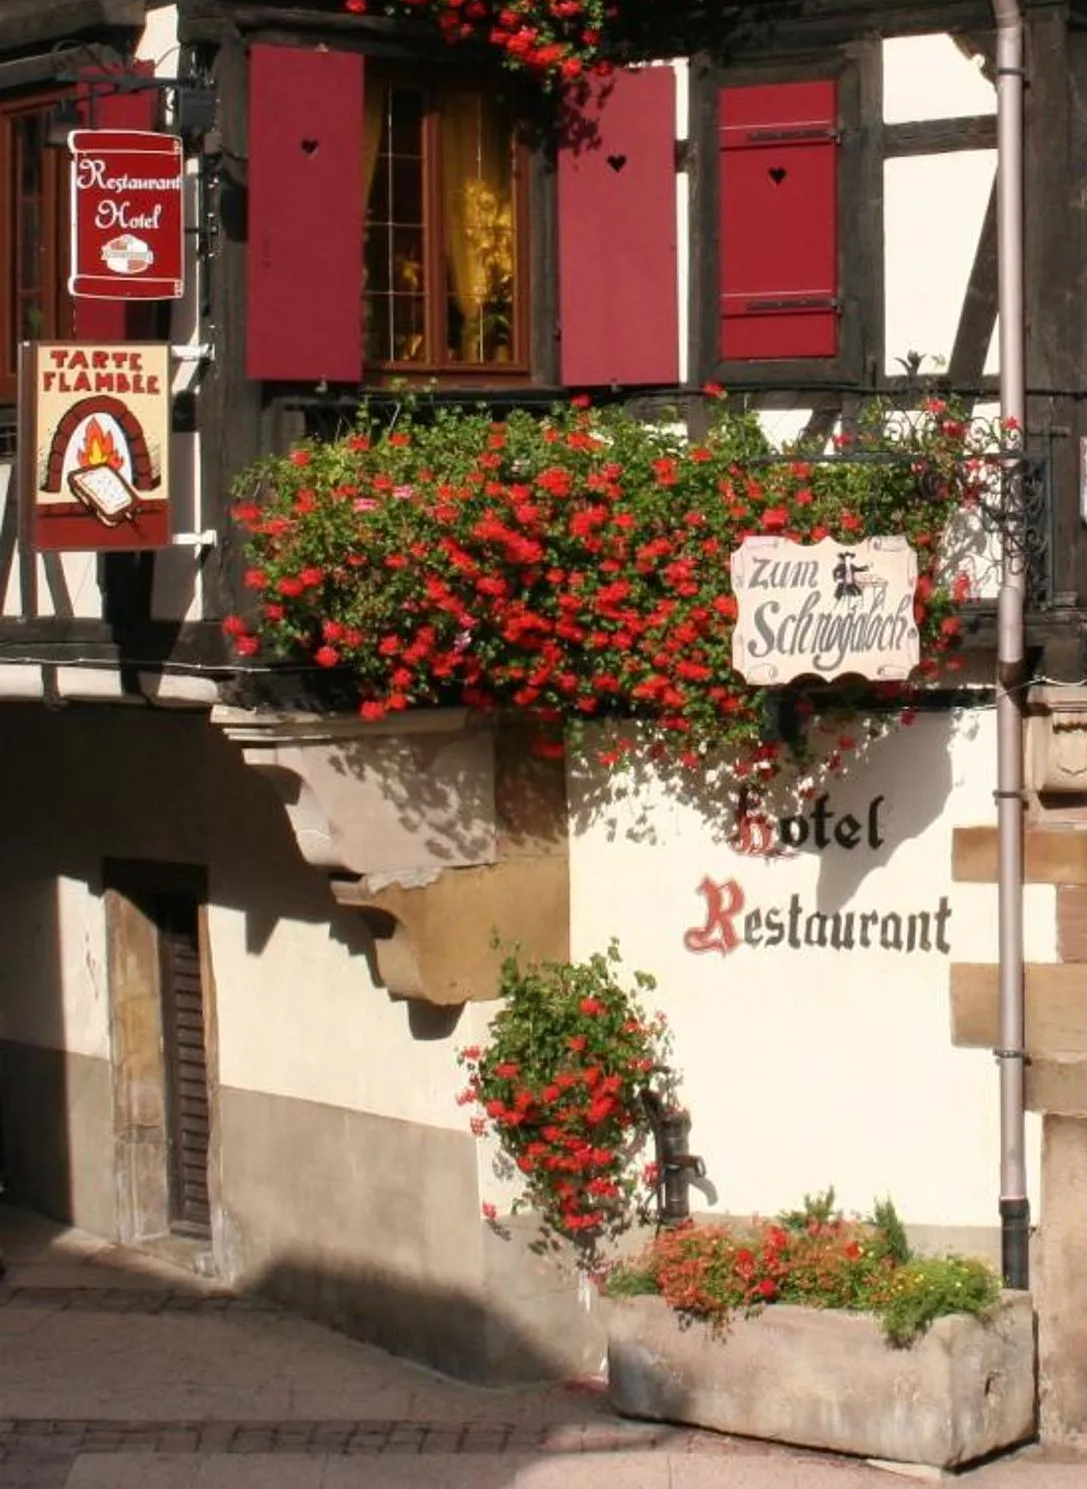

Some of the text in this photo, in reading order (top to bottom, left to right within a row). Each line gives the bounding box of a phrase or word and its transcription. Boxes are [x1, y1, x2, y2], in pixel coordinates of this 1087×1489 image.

[77, 158, 182, 193] Restaurant
[95, 199, 162, 229] Hotel
[50, 350, 143, 371] TARTE
[683, 875, 952, 958] Restaurant
